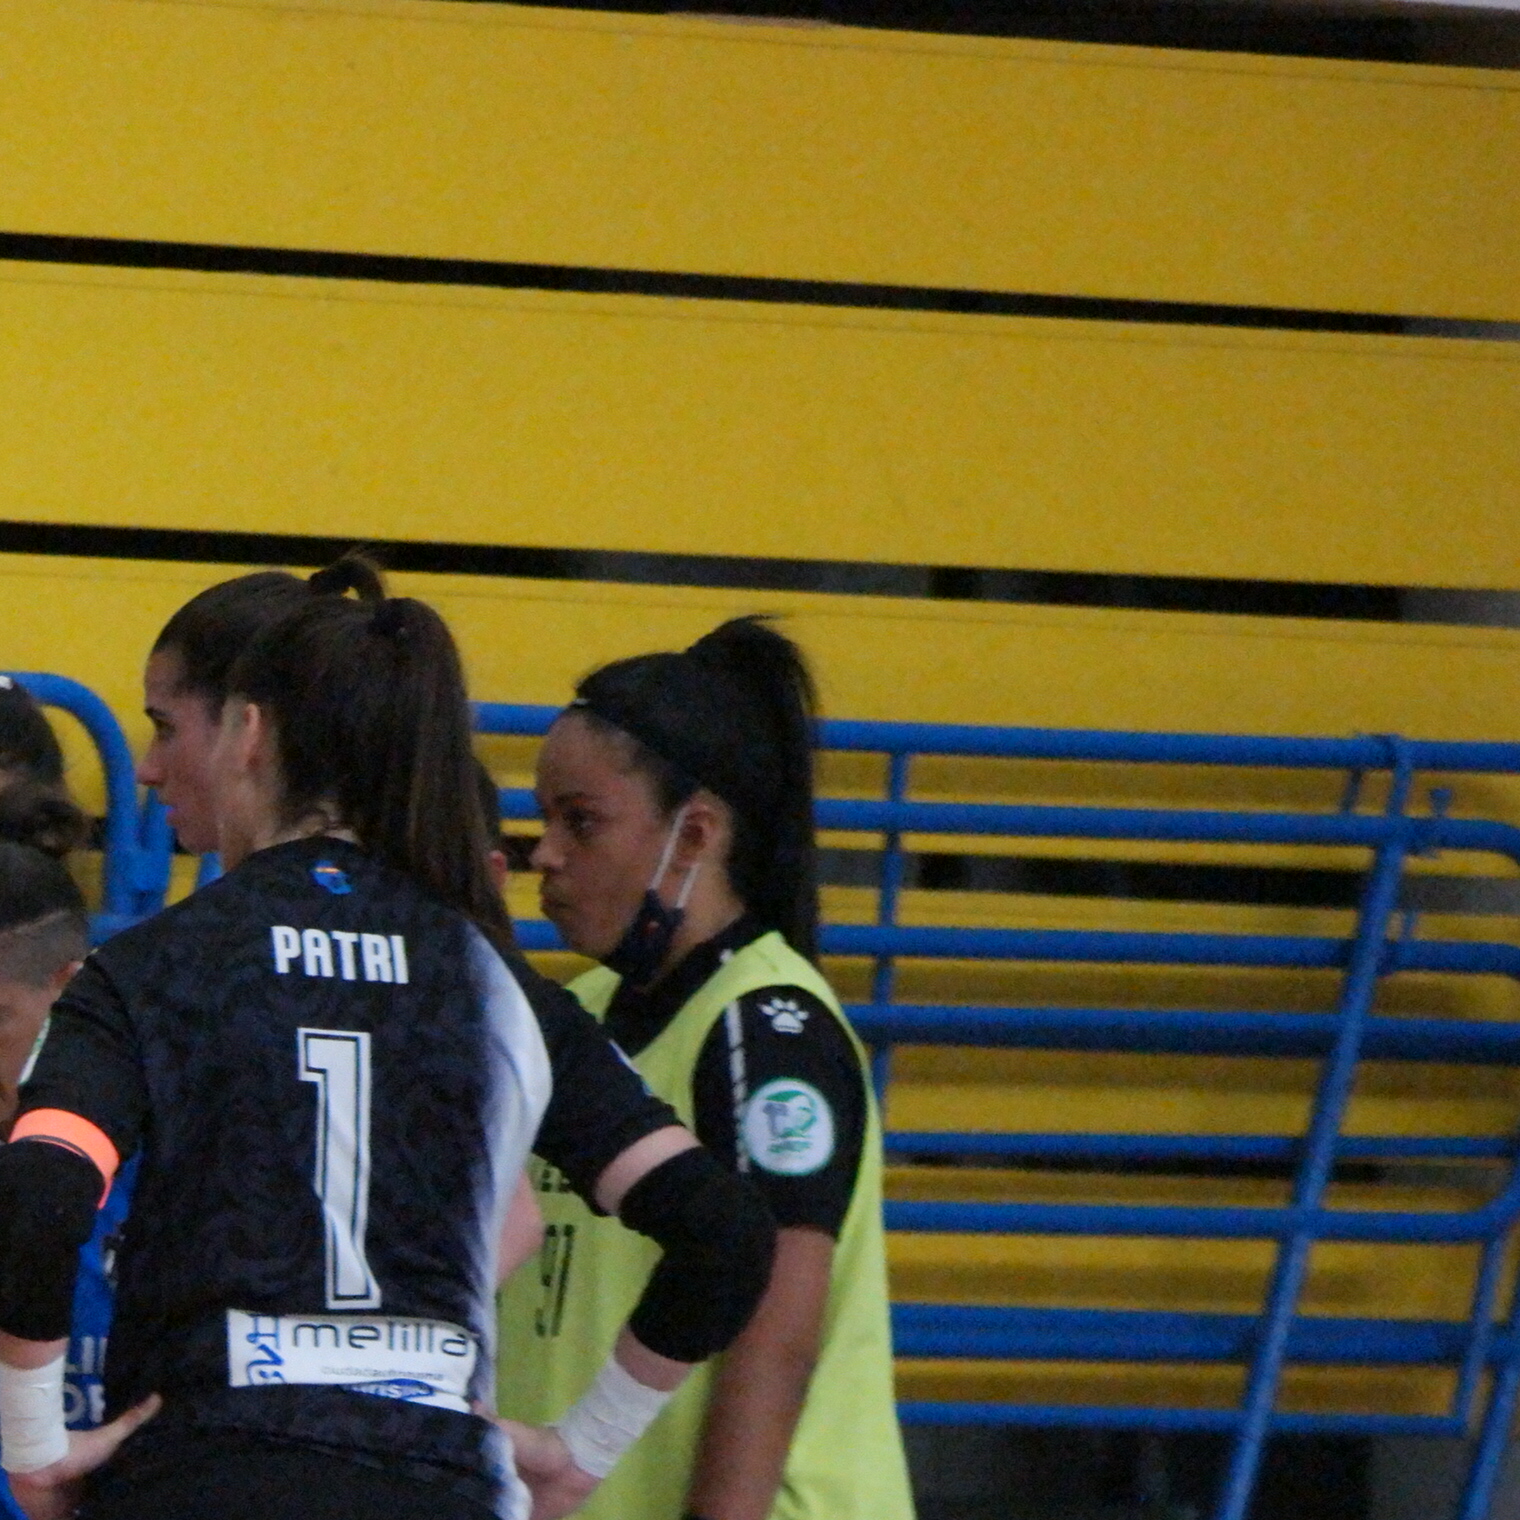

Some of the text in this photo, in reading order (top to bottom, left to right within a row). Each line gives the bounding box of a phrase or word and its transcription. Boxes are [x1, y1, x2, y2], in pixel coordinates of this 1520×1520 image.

[270, 925, 409, 984] PATRI
[297, 1026, 382, 1310] 1
[292, 1320, 469, 1357] melilla
